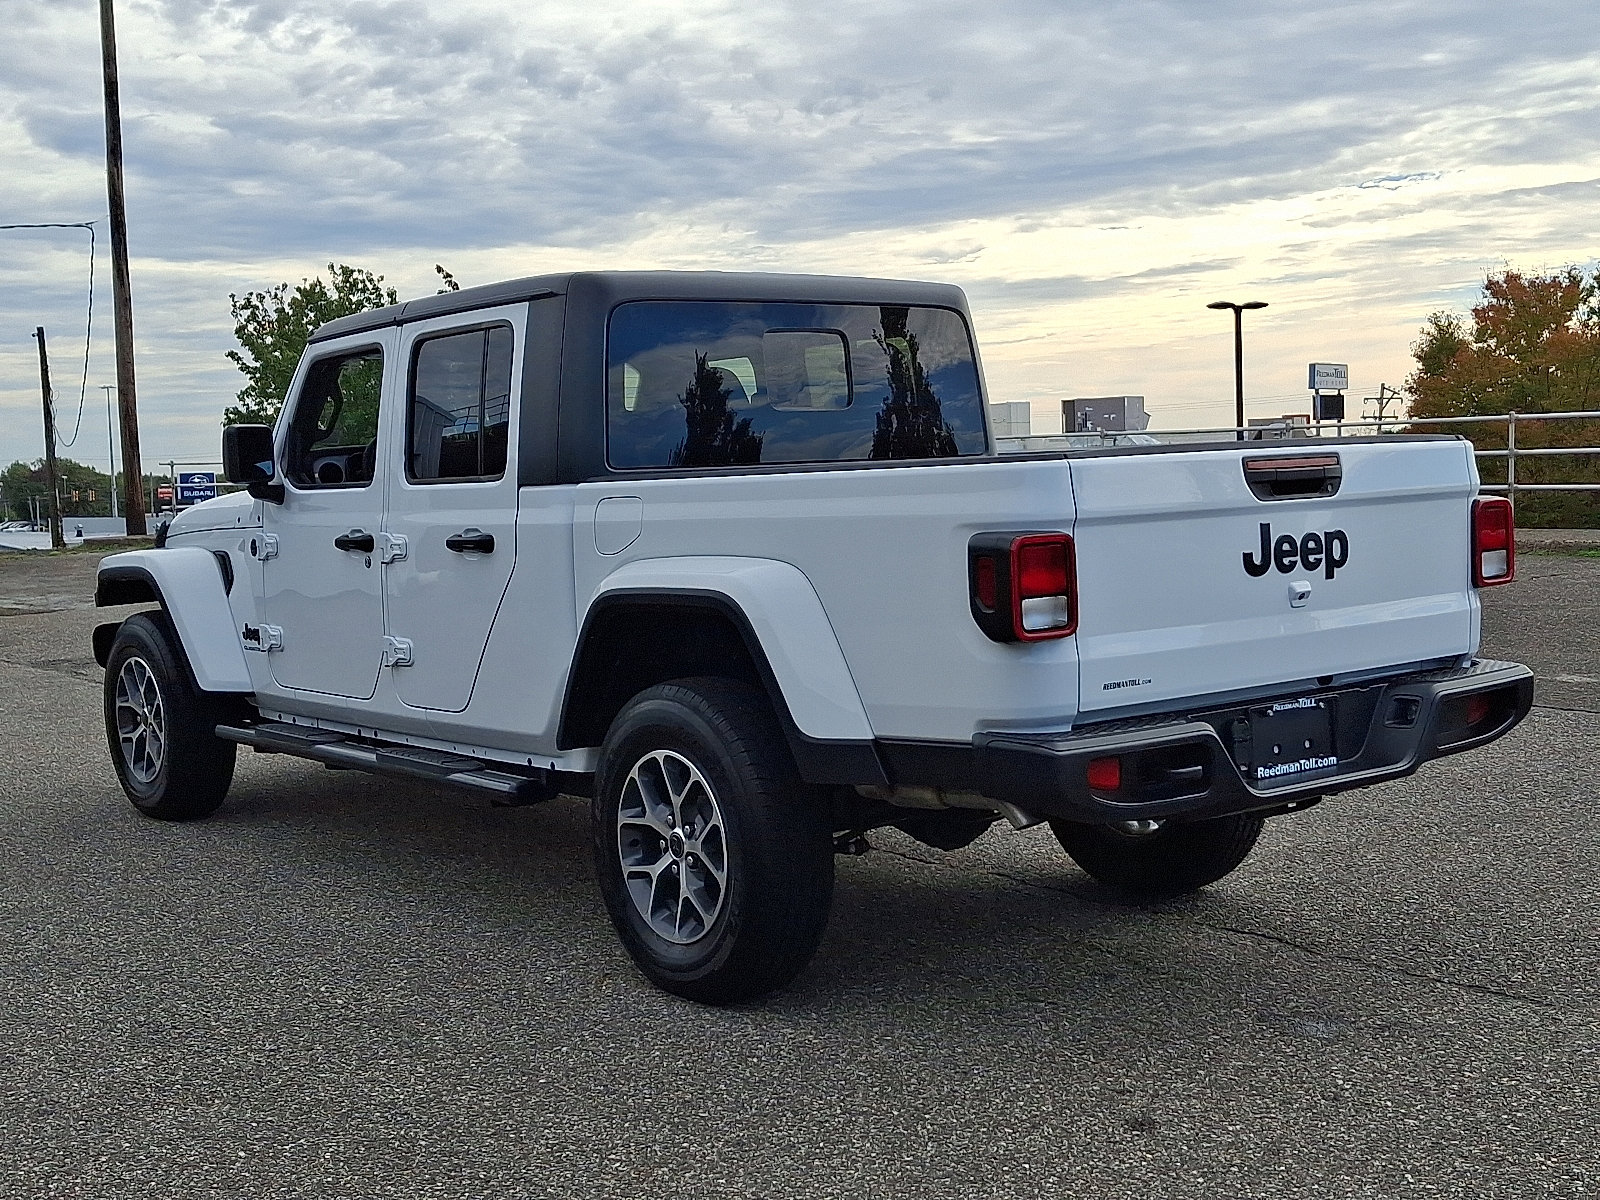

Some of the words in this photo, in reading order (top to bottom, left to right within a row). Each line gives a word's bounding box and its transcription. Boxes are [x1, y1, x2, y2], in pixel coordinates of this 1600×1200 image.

[1242, 522, 1349, 580] Jeep
[241, 622, 261, 646] Jeep
[1257, 756, 1338, 779] ReedmanToll.com
